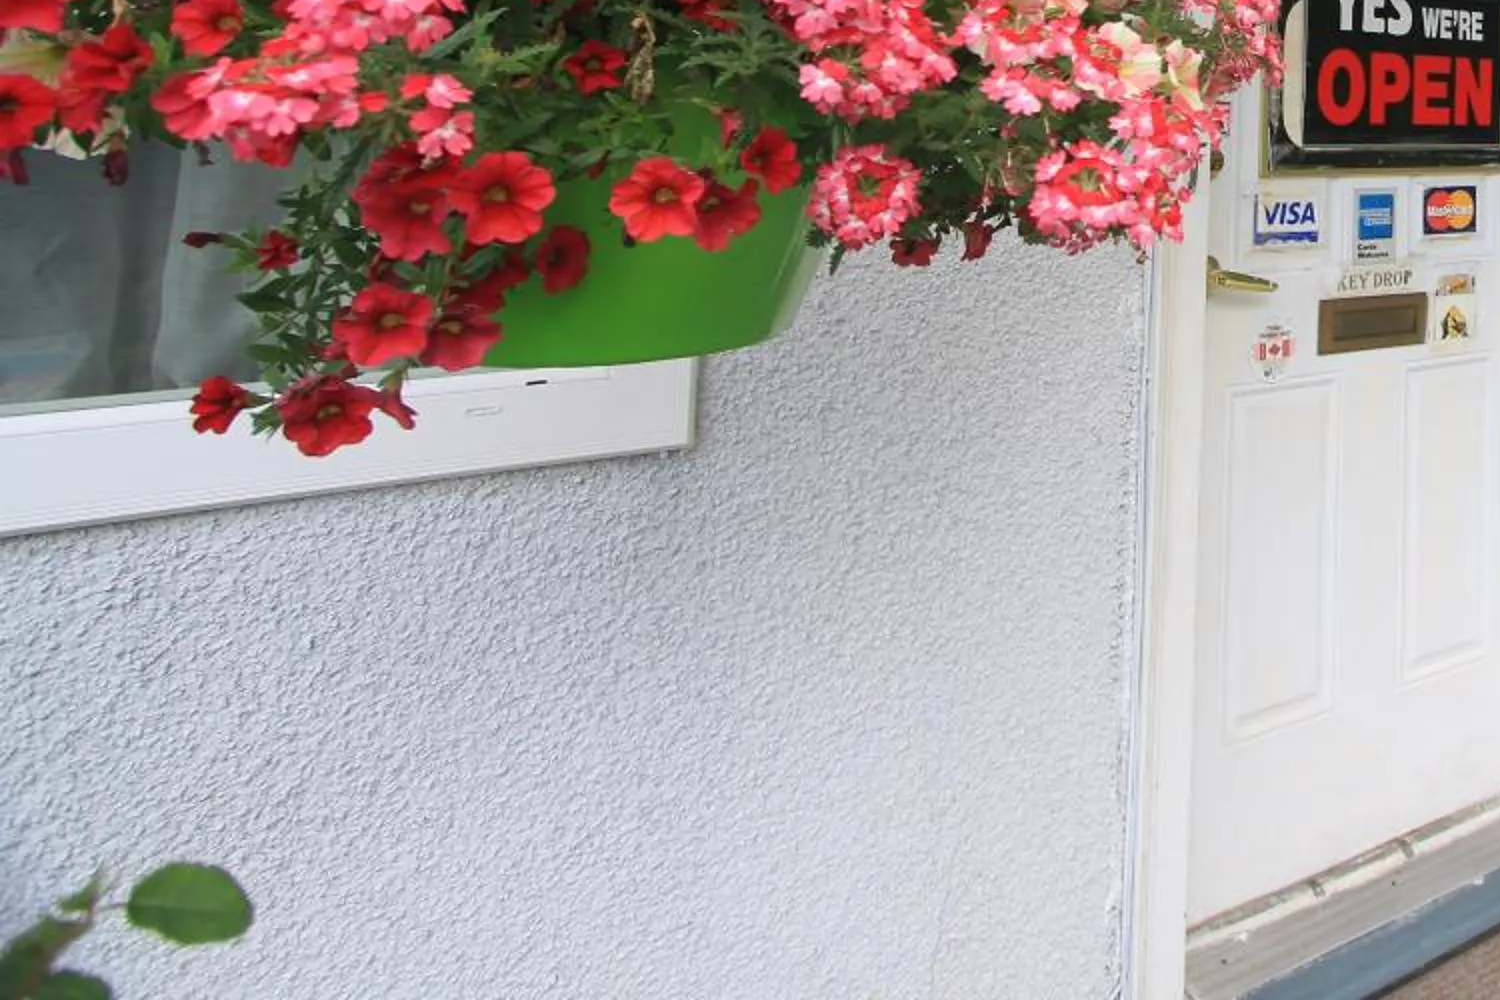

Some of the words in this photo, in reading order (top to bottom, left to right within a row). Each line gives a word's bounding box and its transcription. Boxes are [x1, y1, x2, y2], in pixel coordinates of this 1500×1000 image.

[1422, 7, 1484, 42] WE'RE
[1317, 48, 1494, 127] OPEN
[1264, 201, 1316, 226] VISA
[1373, 269, 1412, 289] DROP
